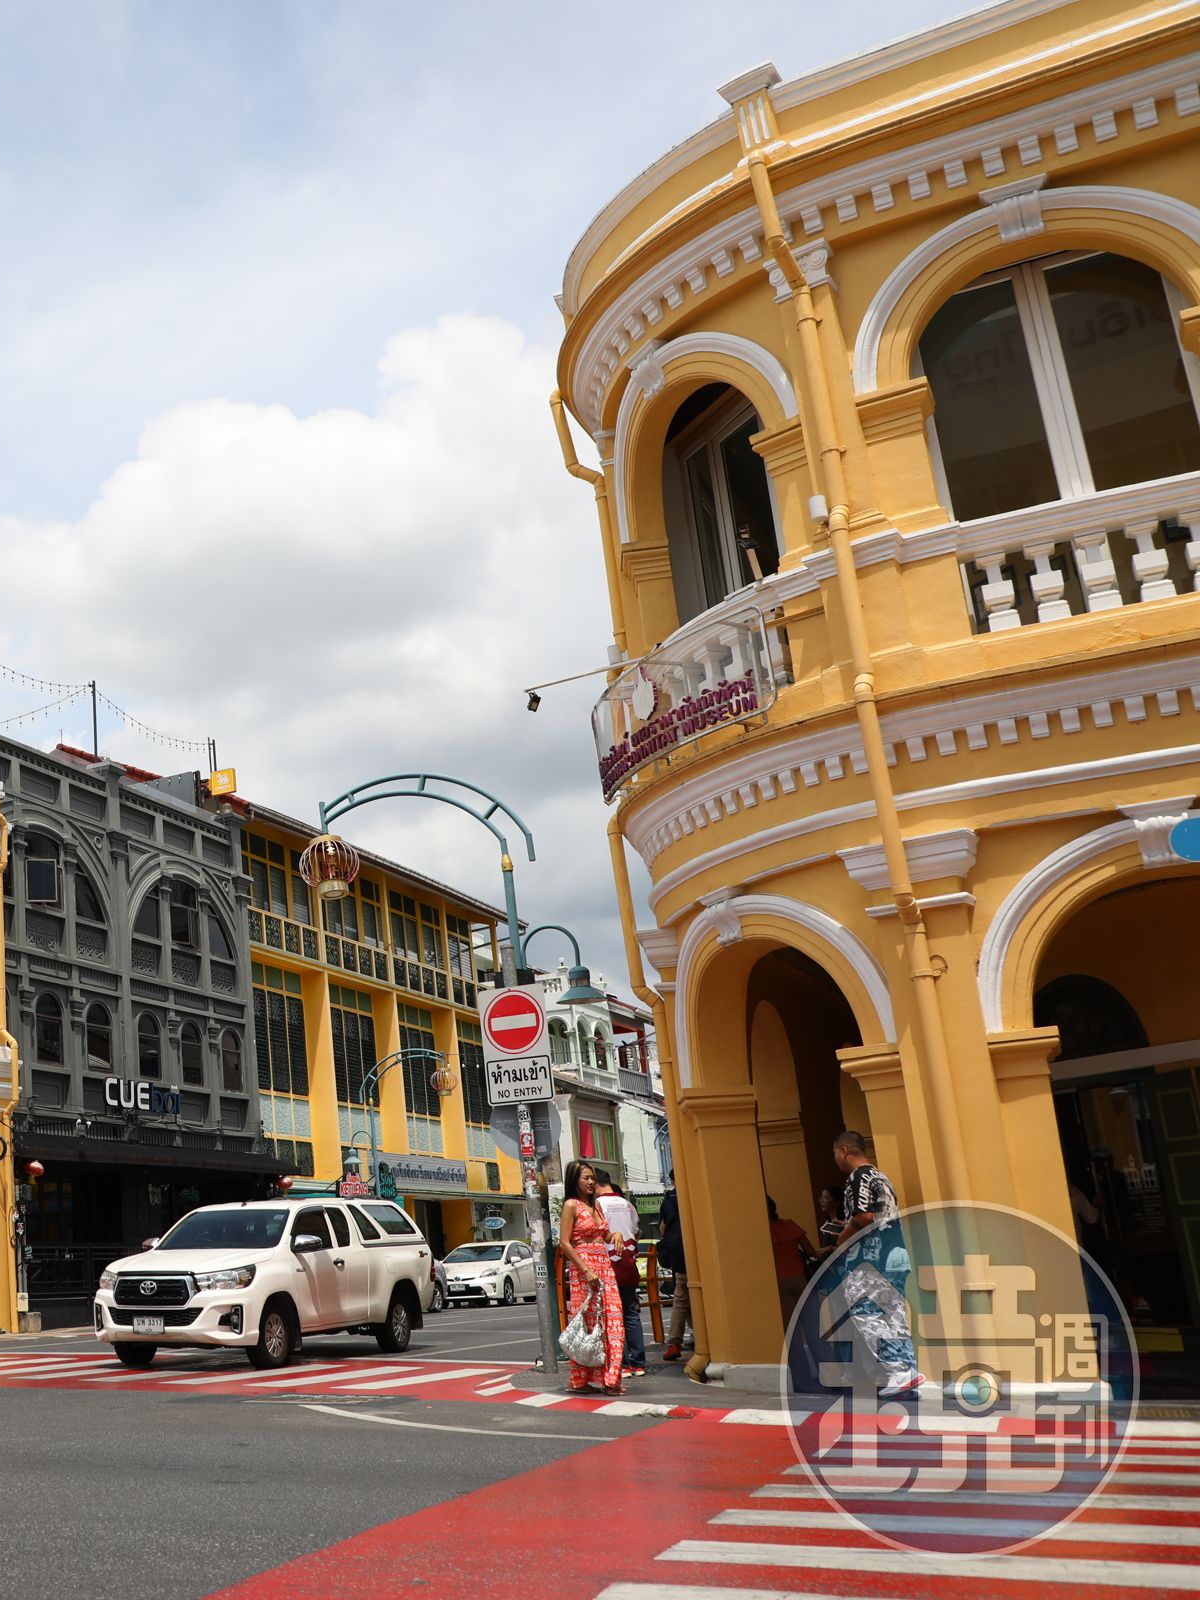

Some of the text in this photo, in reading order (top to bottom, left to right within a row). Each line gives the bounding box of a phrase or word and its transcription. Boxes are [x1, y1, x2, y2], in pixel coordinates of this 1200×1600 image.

[681, 694, 758, 737] MUSEUM
[491, 1060, 548, 1084] ห้ามเข้า
[497, 1086, 543, 1099] NO ENTRY
